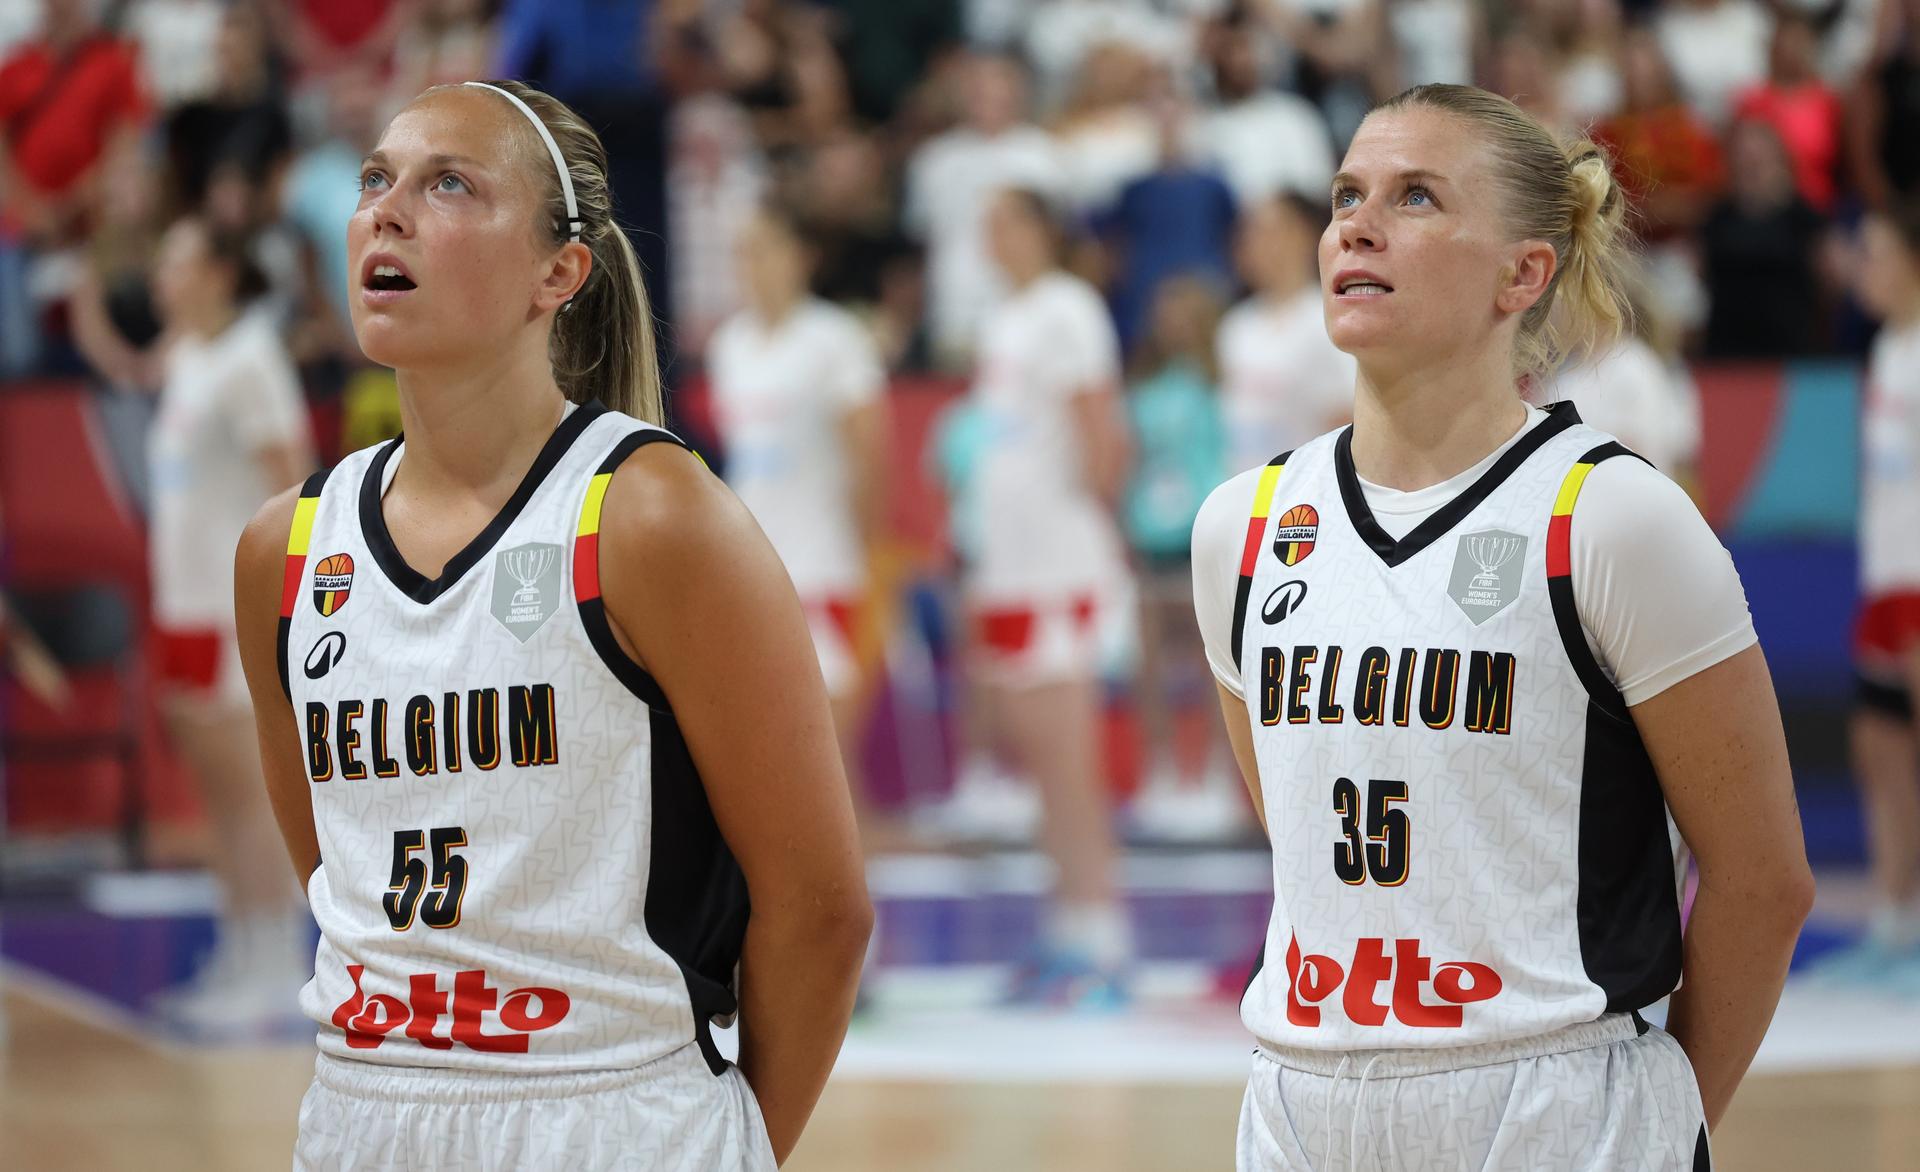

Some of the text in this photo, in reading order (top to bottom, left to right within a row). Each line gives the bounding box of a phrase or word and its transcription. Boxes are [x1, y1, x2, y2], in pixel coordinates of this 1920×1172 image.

[1468, 590, 1498, 599] WOMEN'S
[306, 683, 558, 782] BELGIUM
[1260, 646, 1516, 735] BELGIUM
[382, 826, 467, 931] 55
[1333, 777, 1409, 887] 35
[331, 964, 571, 1053] lotto
[1286, 926, 1503, 1028] lotto
